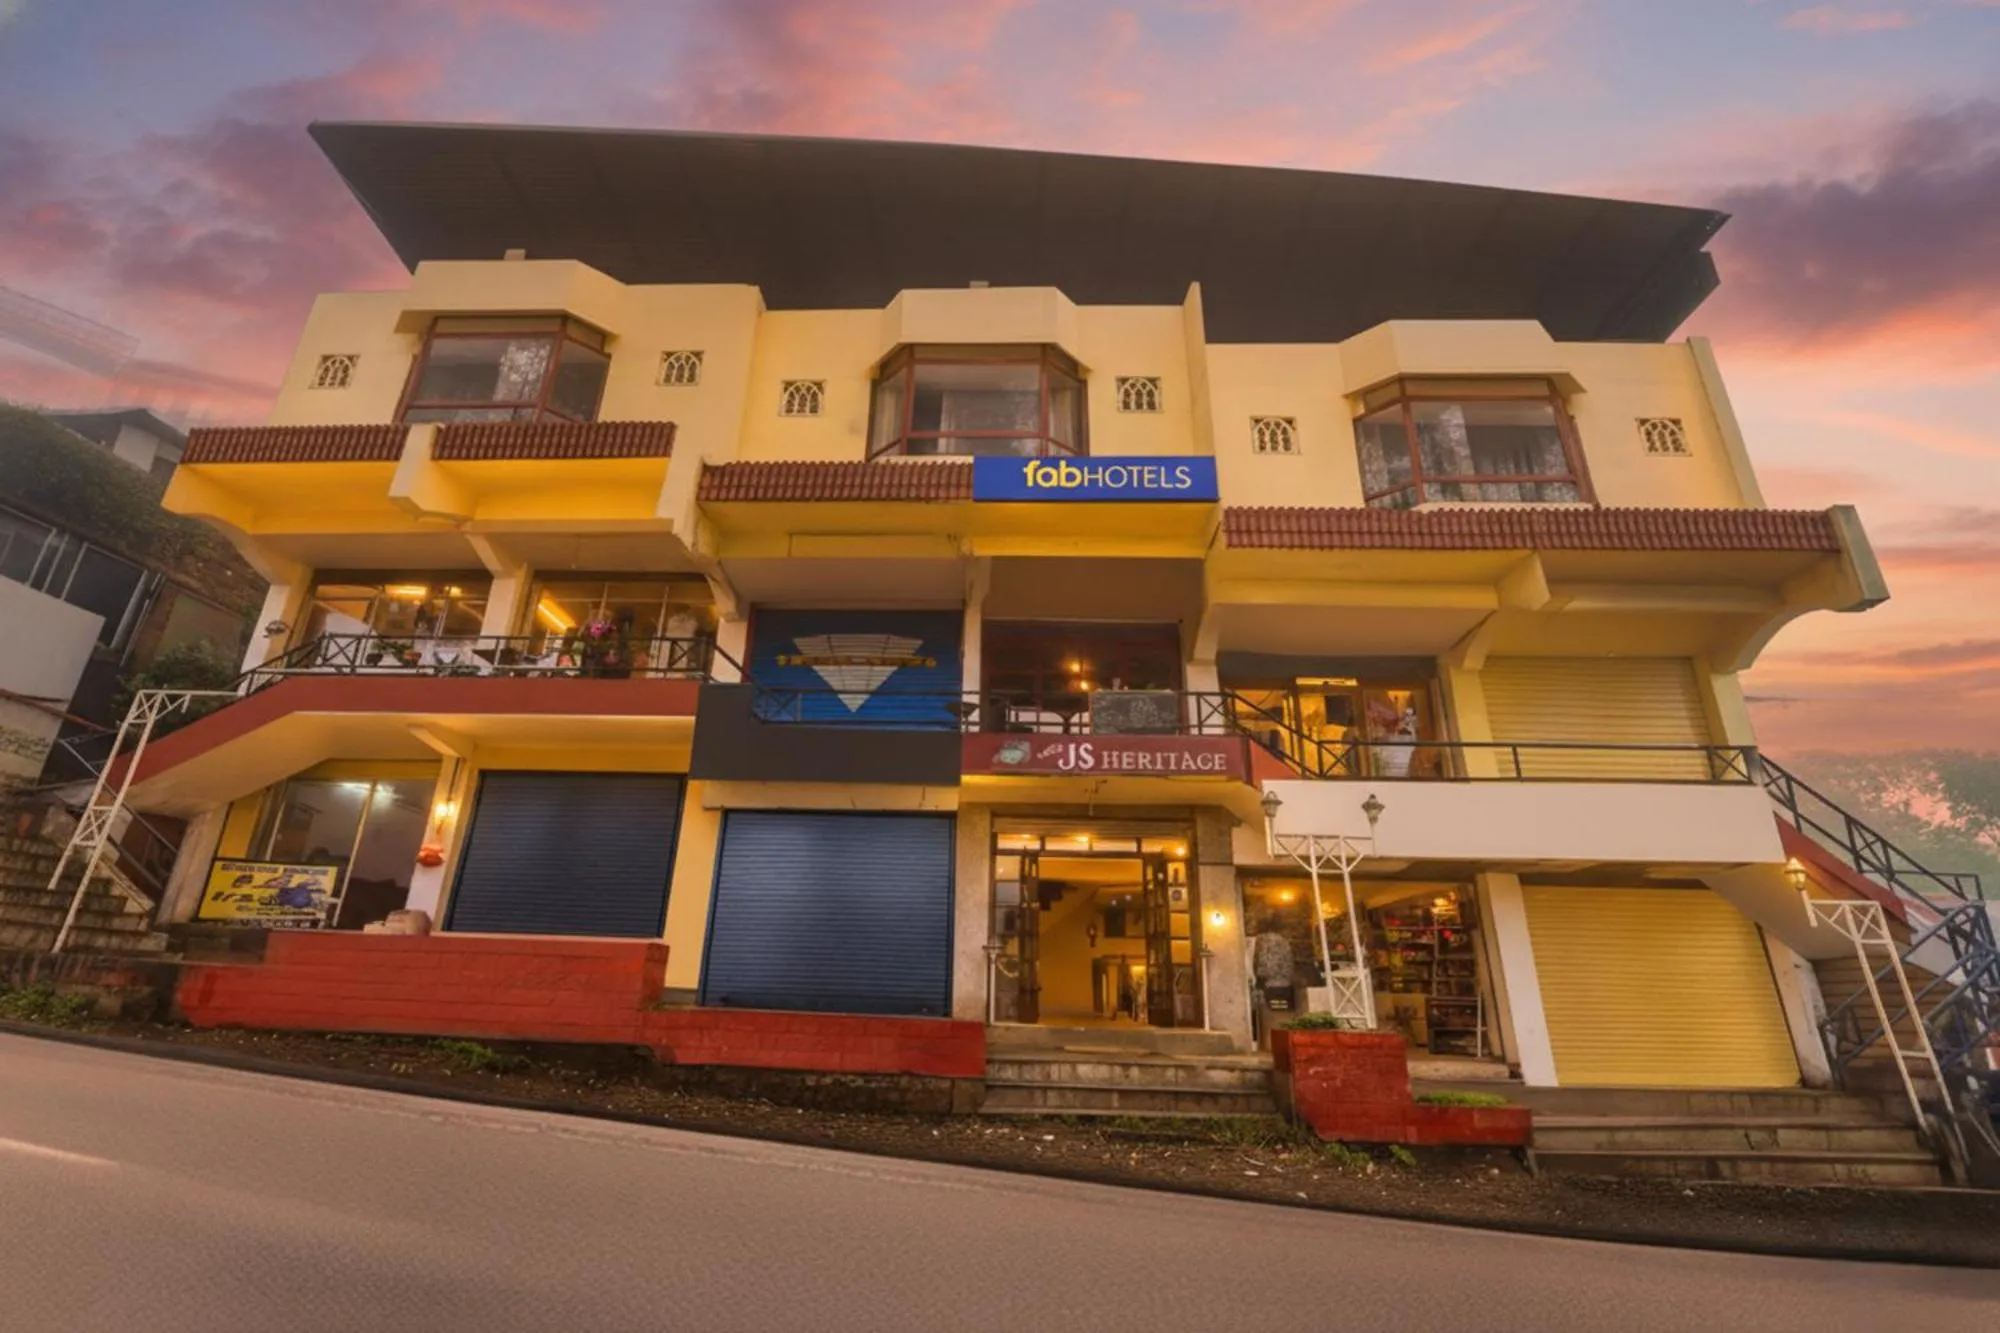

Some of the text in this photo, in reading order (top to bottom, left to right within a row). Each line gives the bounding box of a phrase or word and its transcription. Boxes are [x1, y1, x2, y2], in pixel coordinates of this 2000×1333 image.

[1023, 460, 1192, 489] fabHOTELS
[1057, 743, 1095, 770] JS
[1101, 750, 1227, 770] HERITAGE
